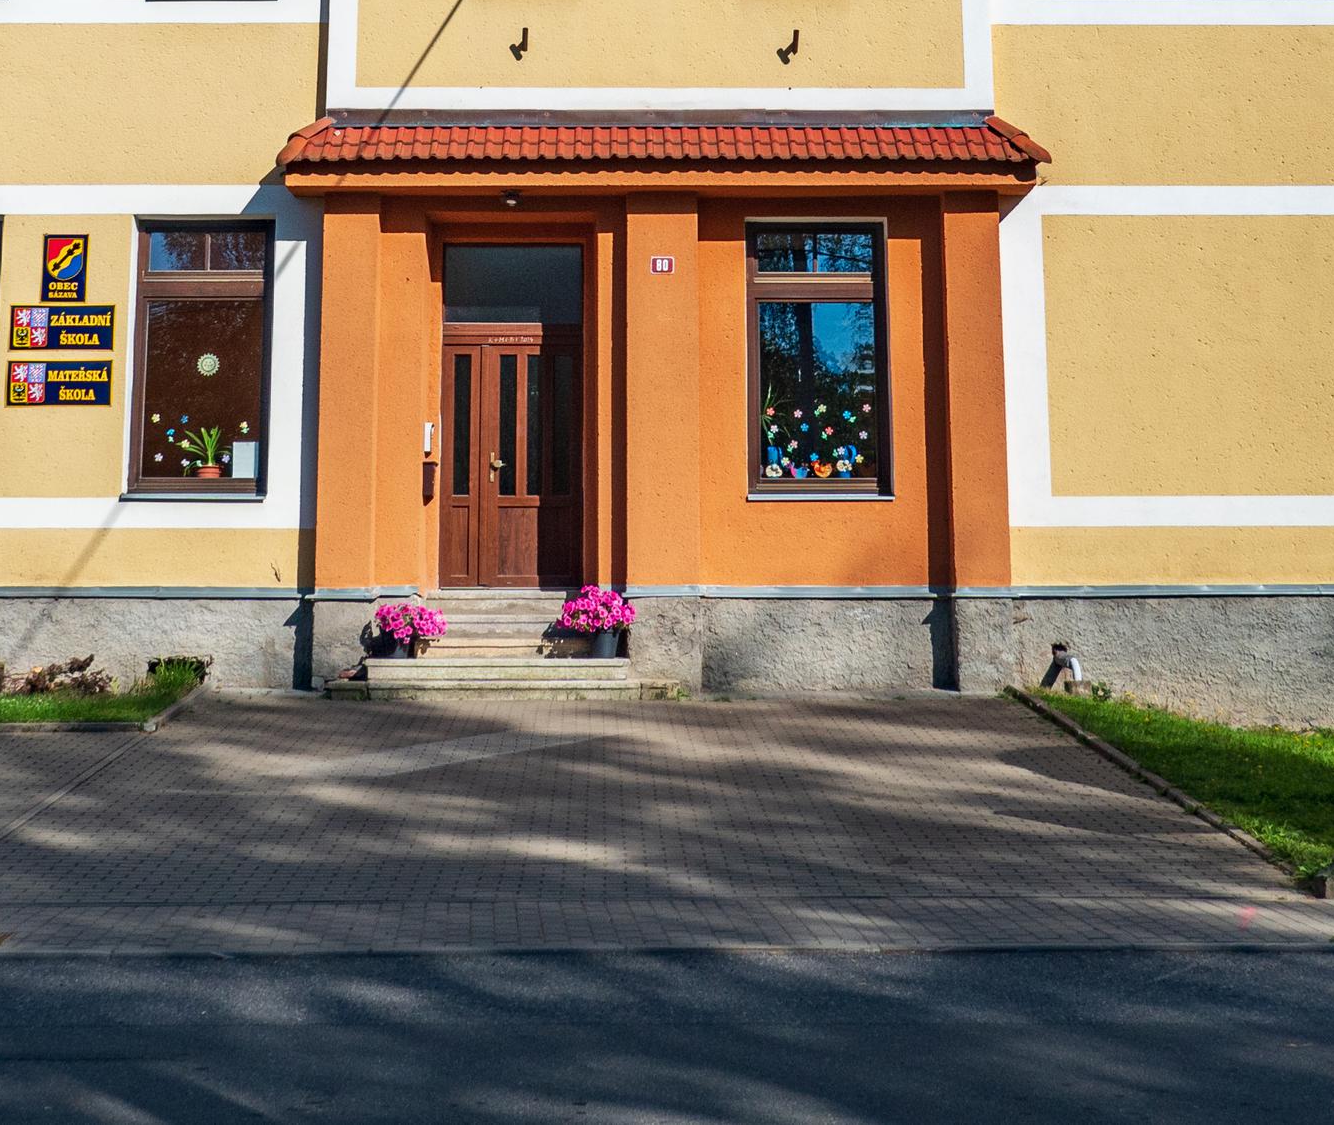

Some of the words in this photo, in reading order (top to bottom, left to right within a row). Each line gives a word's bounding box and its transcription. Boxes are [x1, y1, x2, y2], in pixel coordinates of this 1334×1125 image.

[656, 258, 669, 272] 80
[48, 281, 78, 291] OBEC
[50, 311, 111, 326] ZÁKLADNÍ
[59, 329, 100, 345] ŠKOLA
[47, 366, 108, 382] MATEŘSKÁ
[58, 385, 96, 401] ŠKOLA
